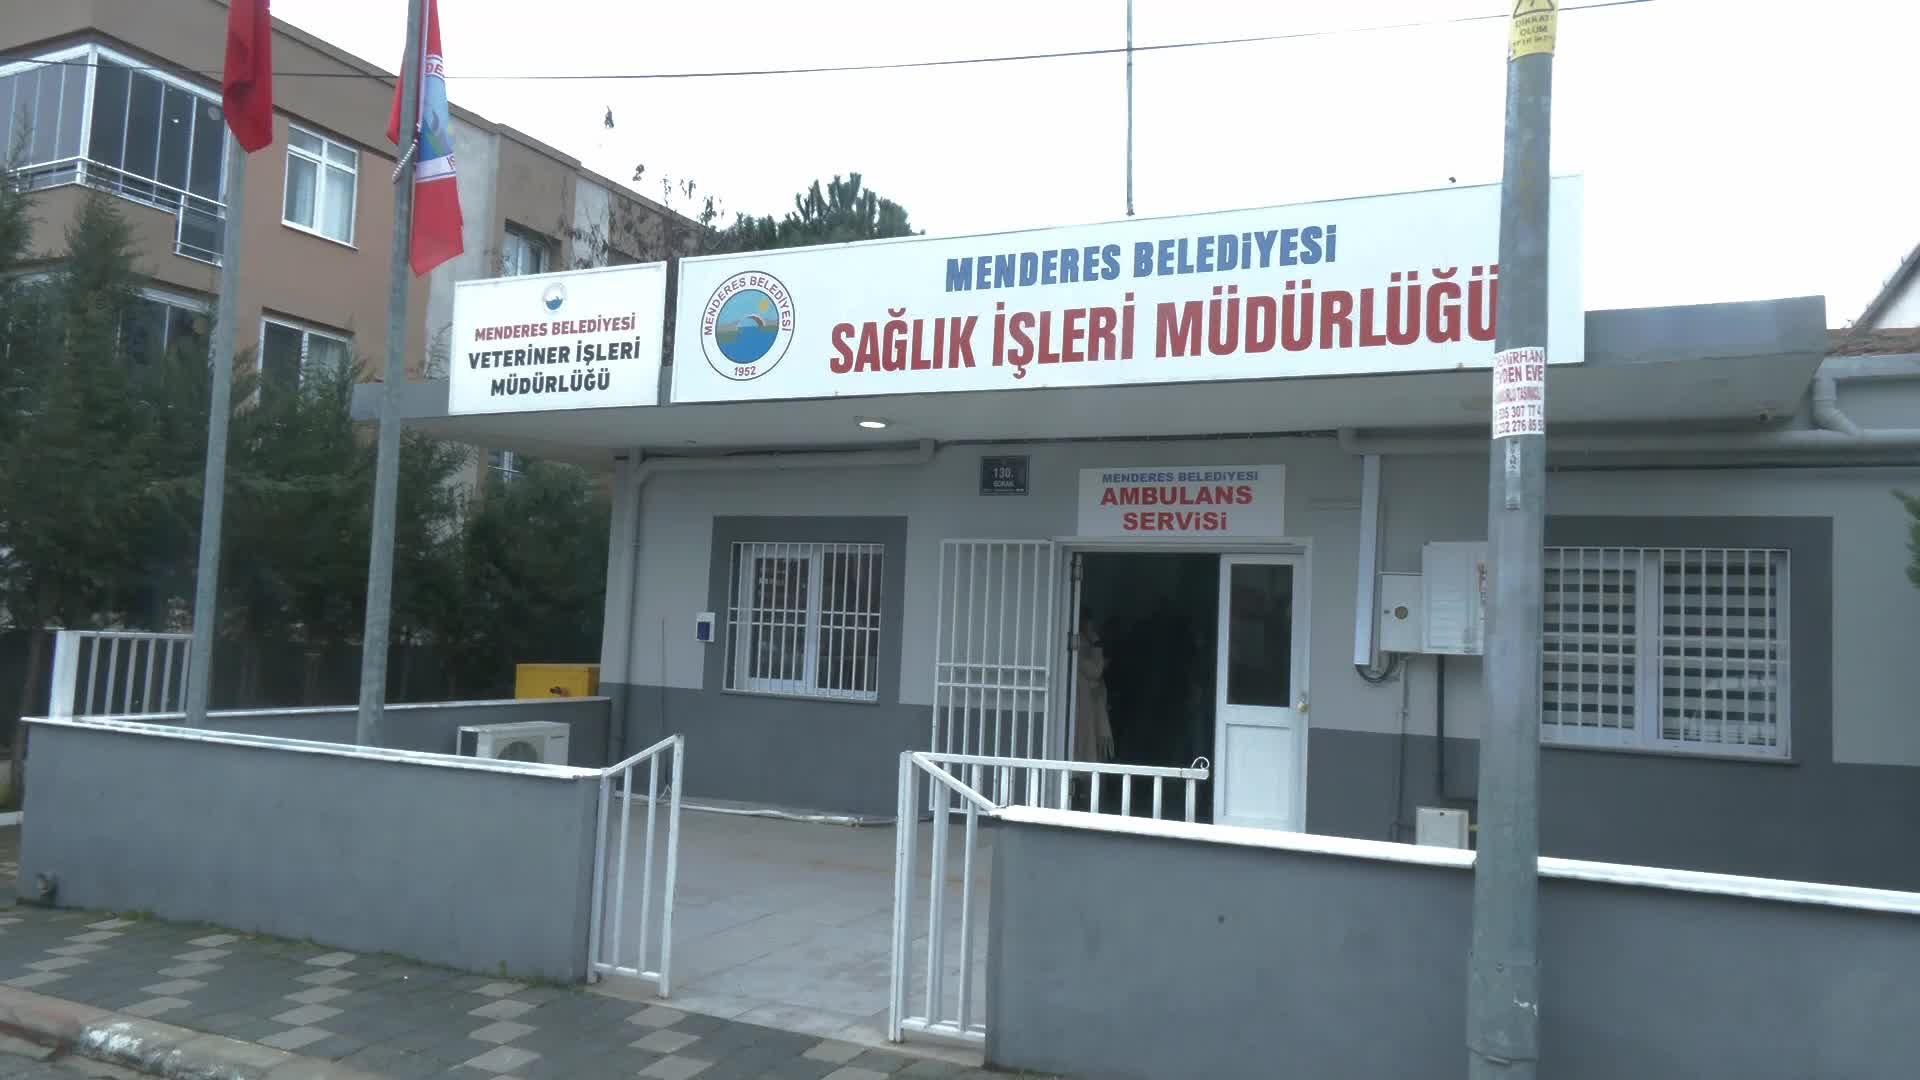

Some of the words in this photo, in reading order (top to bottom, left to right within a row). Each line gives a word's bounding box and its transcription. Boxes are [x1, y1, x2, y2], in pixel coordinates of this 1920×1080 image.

[946, 244, 1121, 292] MENDERES
[704, 277, 746, 336] MENDERES
[475, 323, 548, 342] MENDERES
[552, 313, 636, 336] BELEDİYESİ
[830, 308, 979, 374] SAĞLIK
[992, 292, 1135, 380] İŞLERİ
[1155, 264, 1499, 358] MÜDÜRLÜĞÜ
[468, 344, 570, 369] VETERİNER
[576, 336, 640, 365] İŞLERİ
[491, 368, 610, 396] MÜDÜRLÜĞÜ
[734, 366, 756, 376] 1952
[1526, 364, 1543, 381] EVE
[1102, 472, 1174, 484] MENDERES
[1100, 485, 1254, 506] AMBULANS
